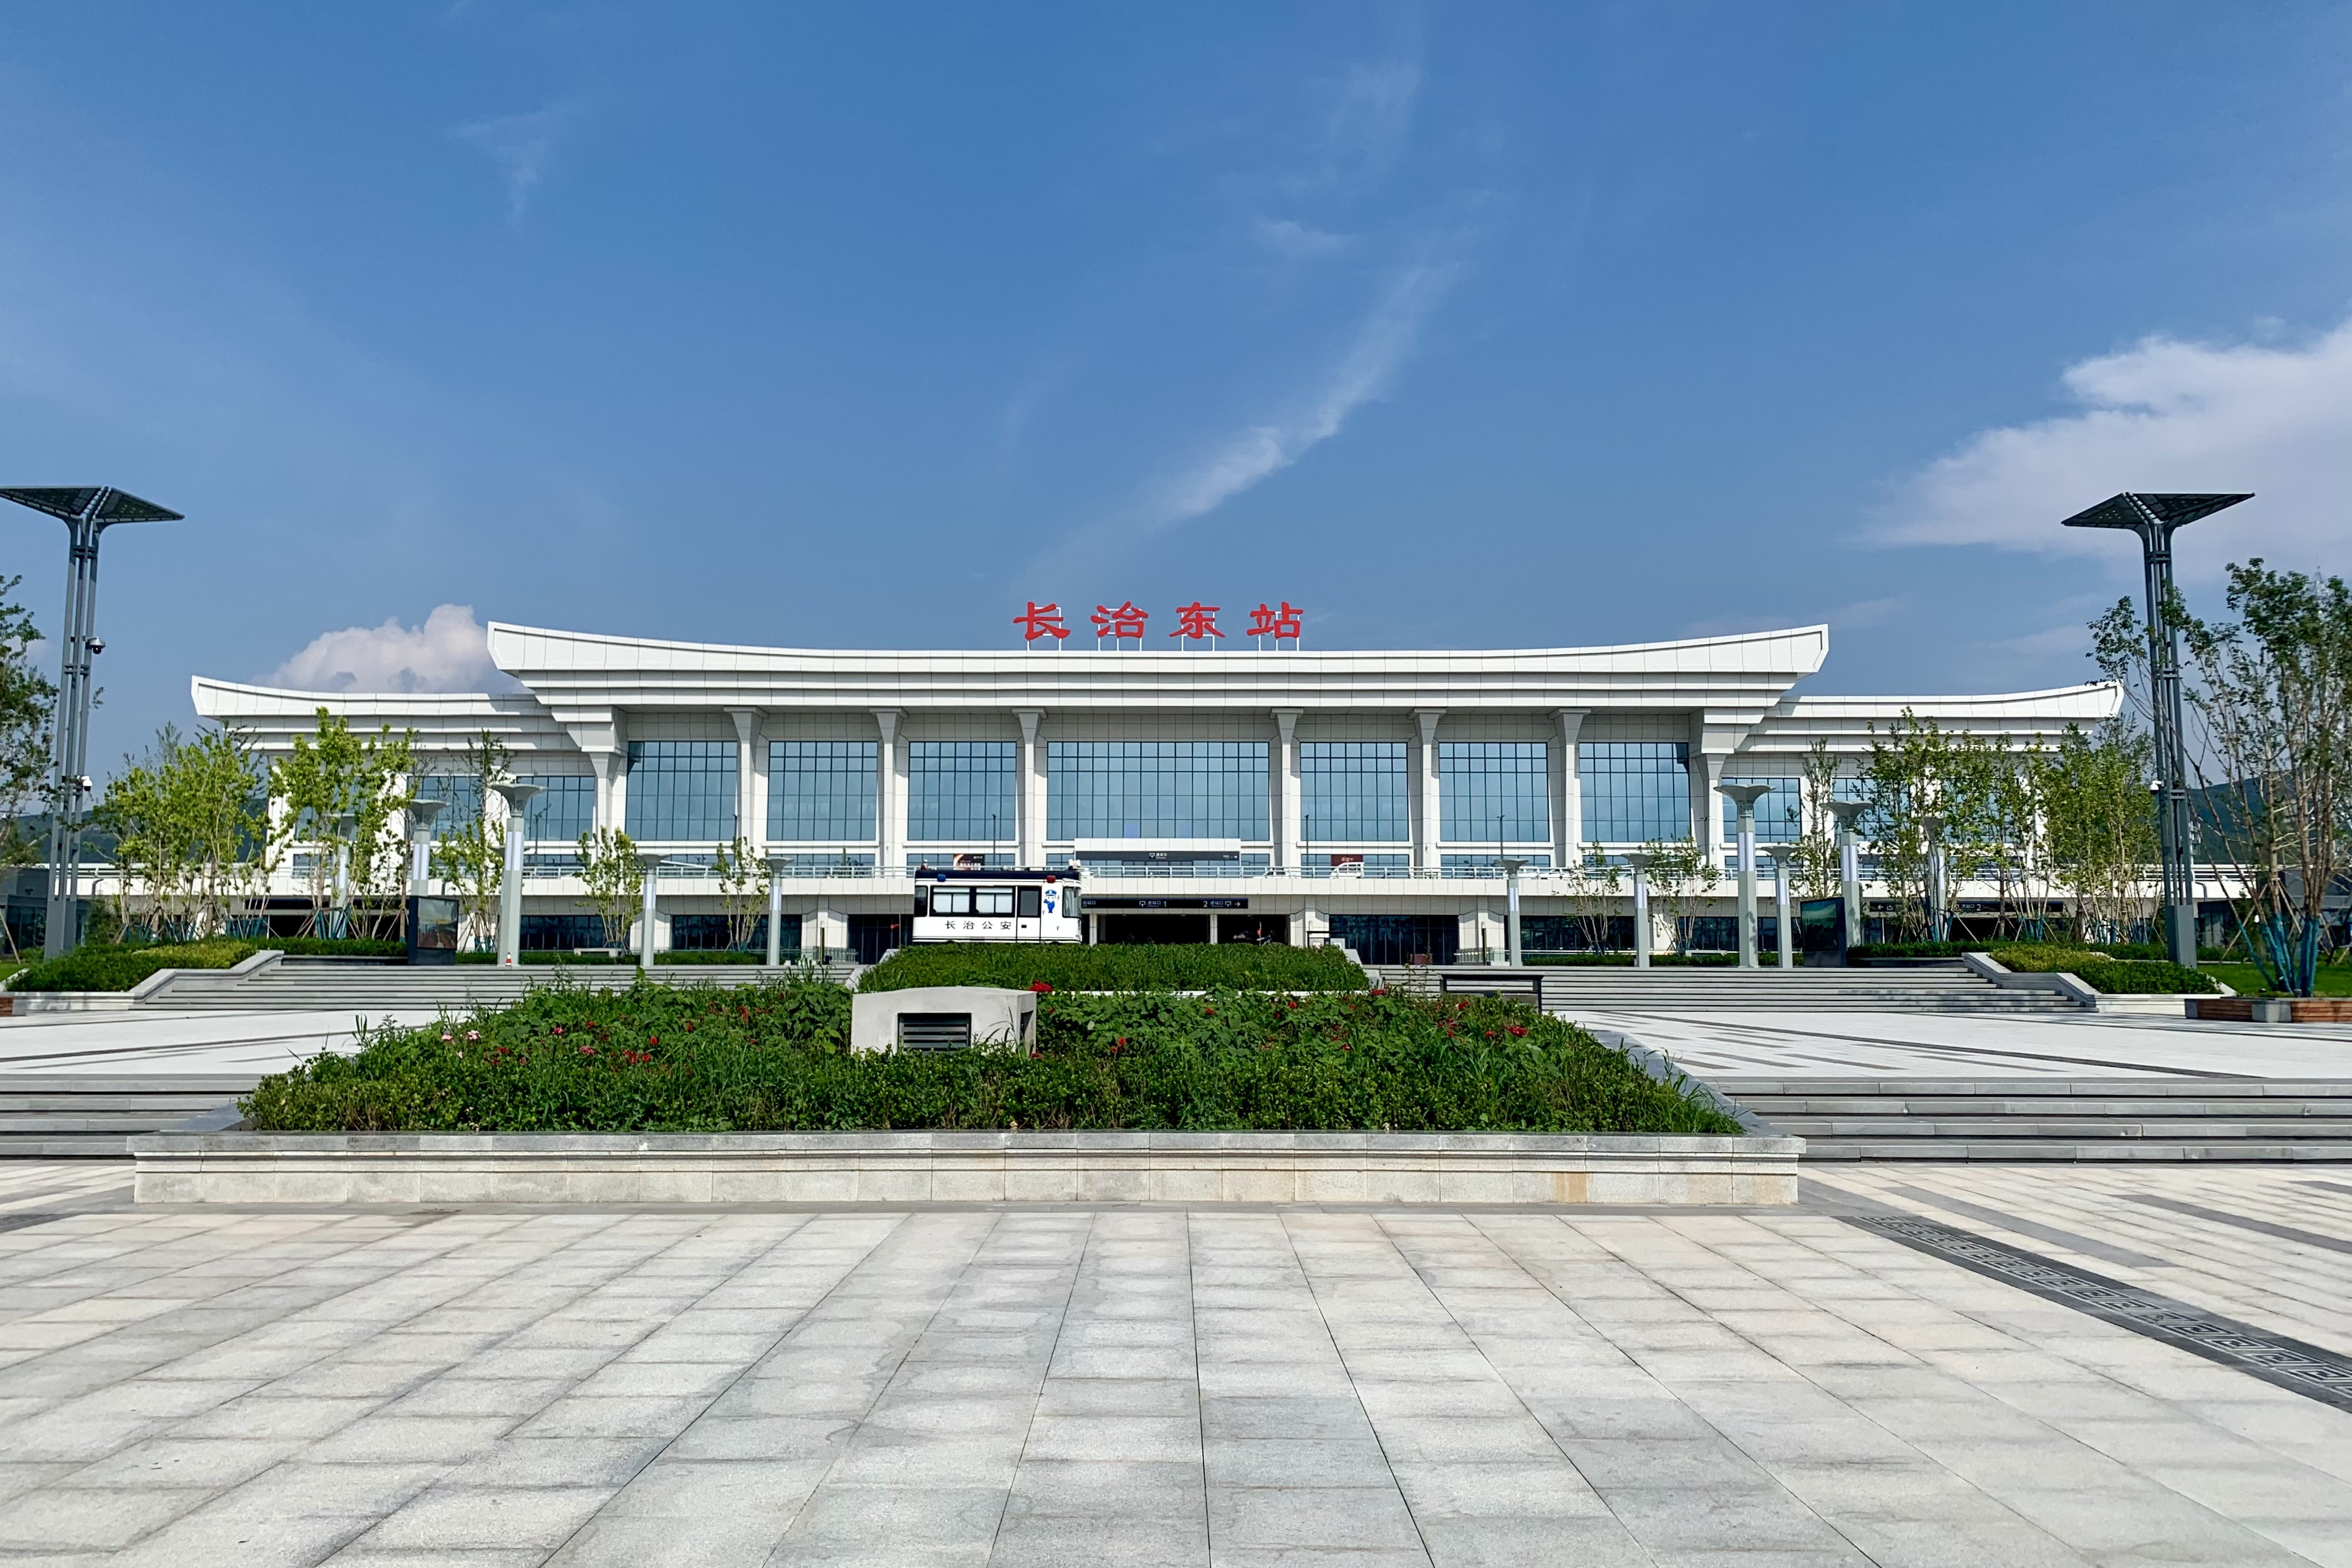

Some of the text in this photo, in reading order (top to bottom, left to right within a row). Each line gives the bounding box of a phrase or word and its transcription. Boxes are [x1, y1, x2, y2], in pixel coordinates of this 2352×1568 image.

[1013, 601, 1304, 640] 长治东站
[945, 921, 1012, 930] 长治公安
